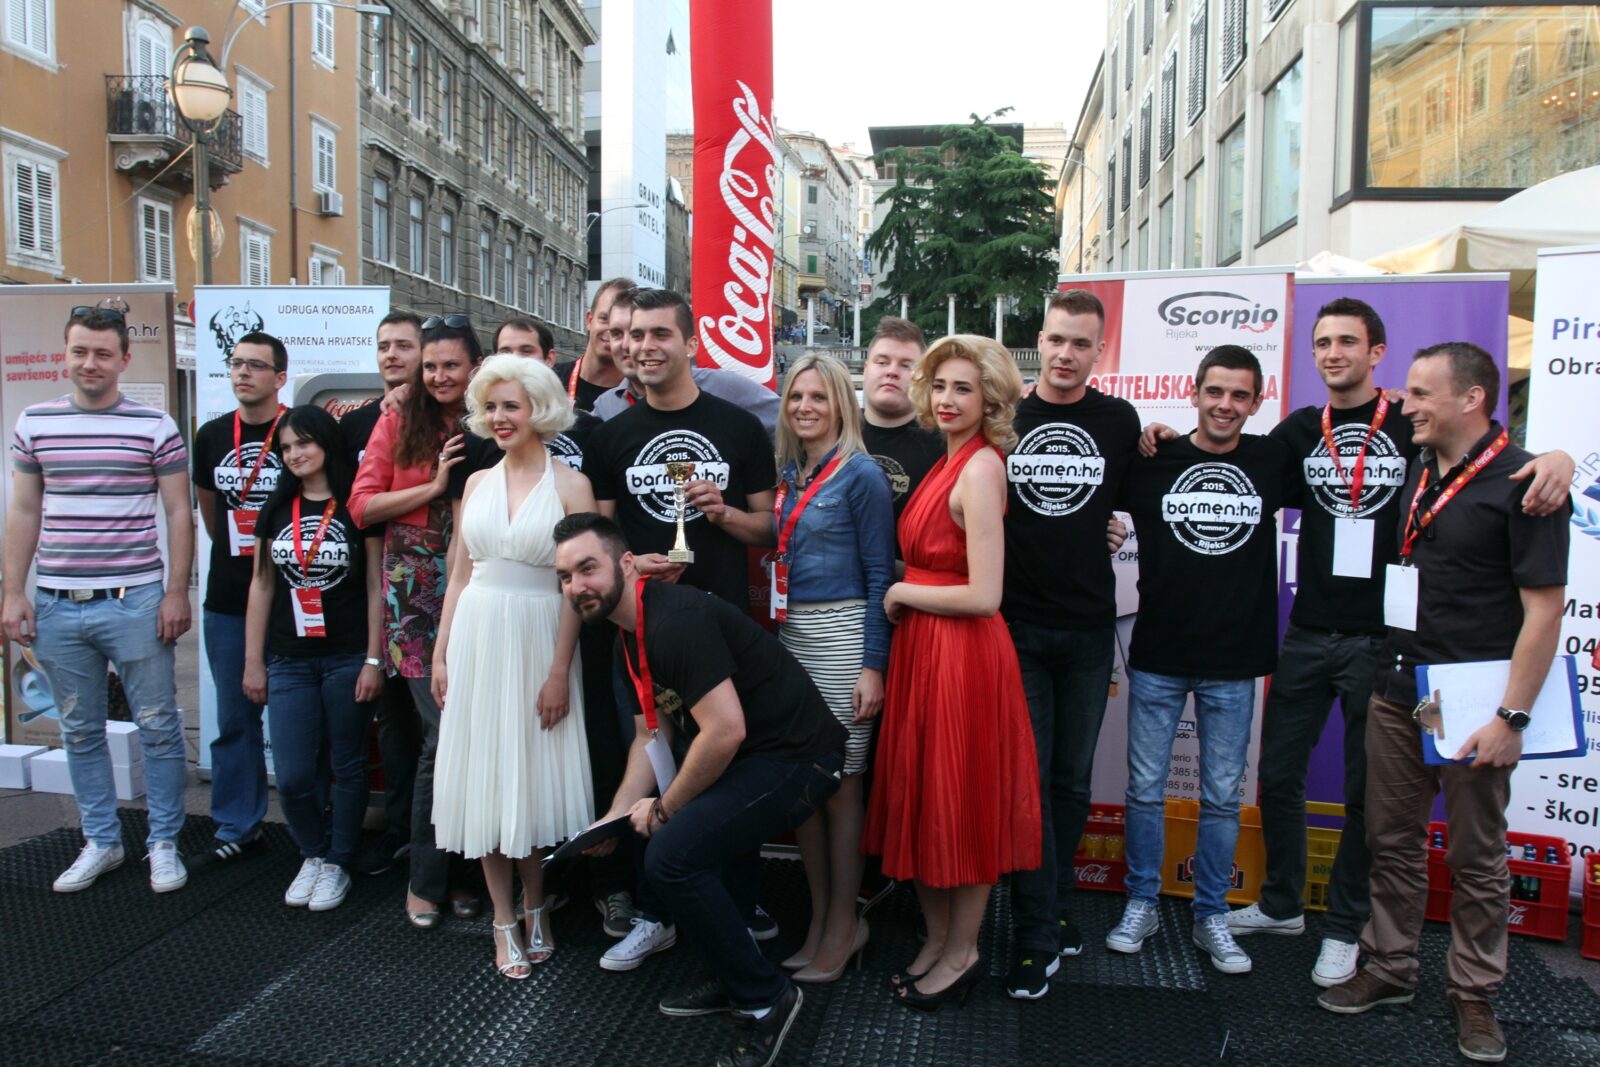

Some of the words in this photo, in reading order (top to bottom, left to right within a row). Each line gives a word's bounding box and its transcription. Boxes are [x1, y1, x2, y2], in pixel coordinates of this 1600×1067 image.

[639, 183, 660, 209] GRAND
[639, 209, 660, 235] HOTEL
[278, 305, 319, 315] UDRUGA
[322, 305, 375, 315] KONOBARA
[1167, 303, 1278, 330] Scorpio
[1165, 329, 1199, 341] Rijeka
[277, 336, 326, 346] BARMENA
[328, 337, 374, 346] HRVATSKE
[1040, 486, 1072, 494] Pommery
[1041, 501, 1067, 511] Rijeka
[1196, 524, 1230, 533] Pommery
[1198, 540, 1226, 550] Rijeka
